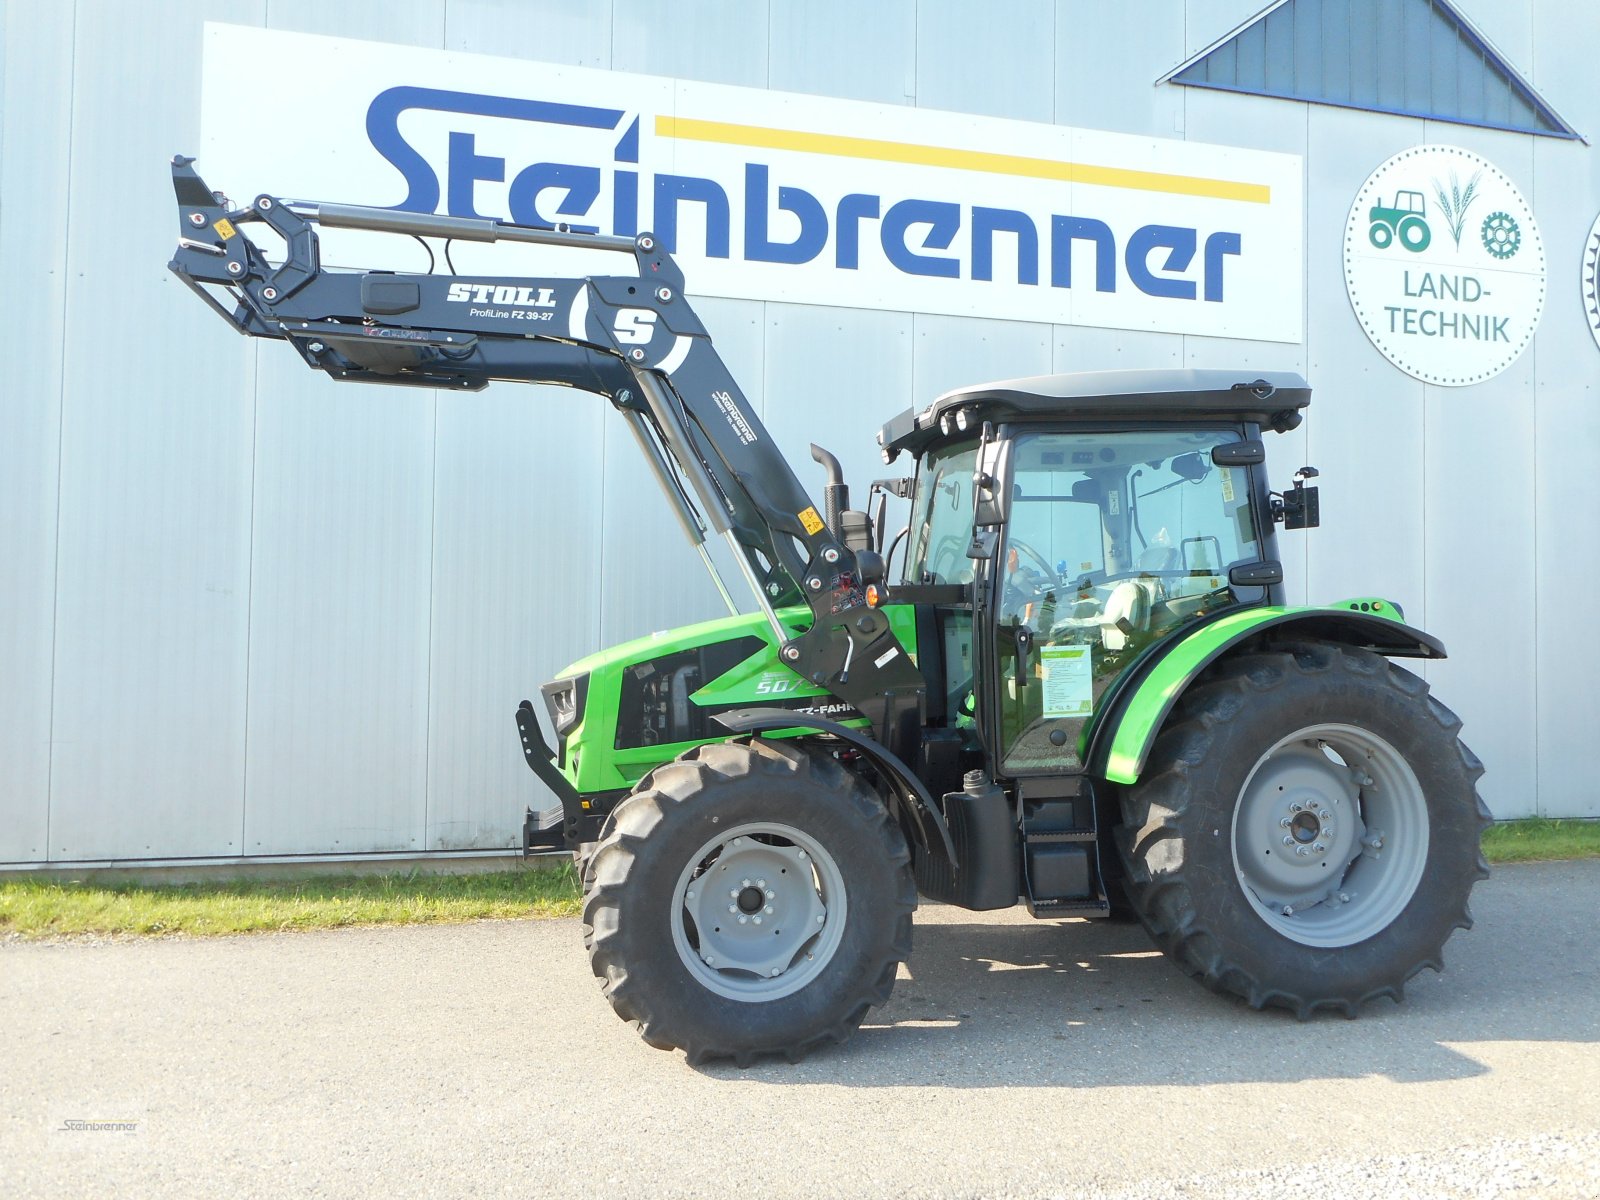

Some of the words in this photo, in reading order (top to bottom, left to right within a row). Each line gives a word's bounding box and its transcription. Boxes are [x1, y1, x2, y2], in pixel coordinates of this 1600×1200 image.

[364, 85, 1241, 302] Steinbrenner
[446, 282, 557, 308] STOLL
[1403, 270, 1492, 303] LAND-
[469, 307, 510, 319] ProfiLine
[511, 310, 525, 320] FZ
[525, 311, 554, 321] 39-27
[612, 307, 659, 345] S
[1384, 305, 1512, 343] TECHNIK
[715, 391, 757, 443] Steinbrenner
